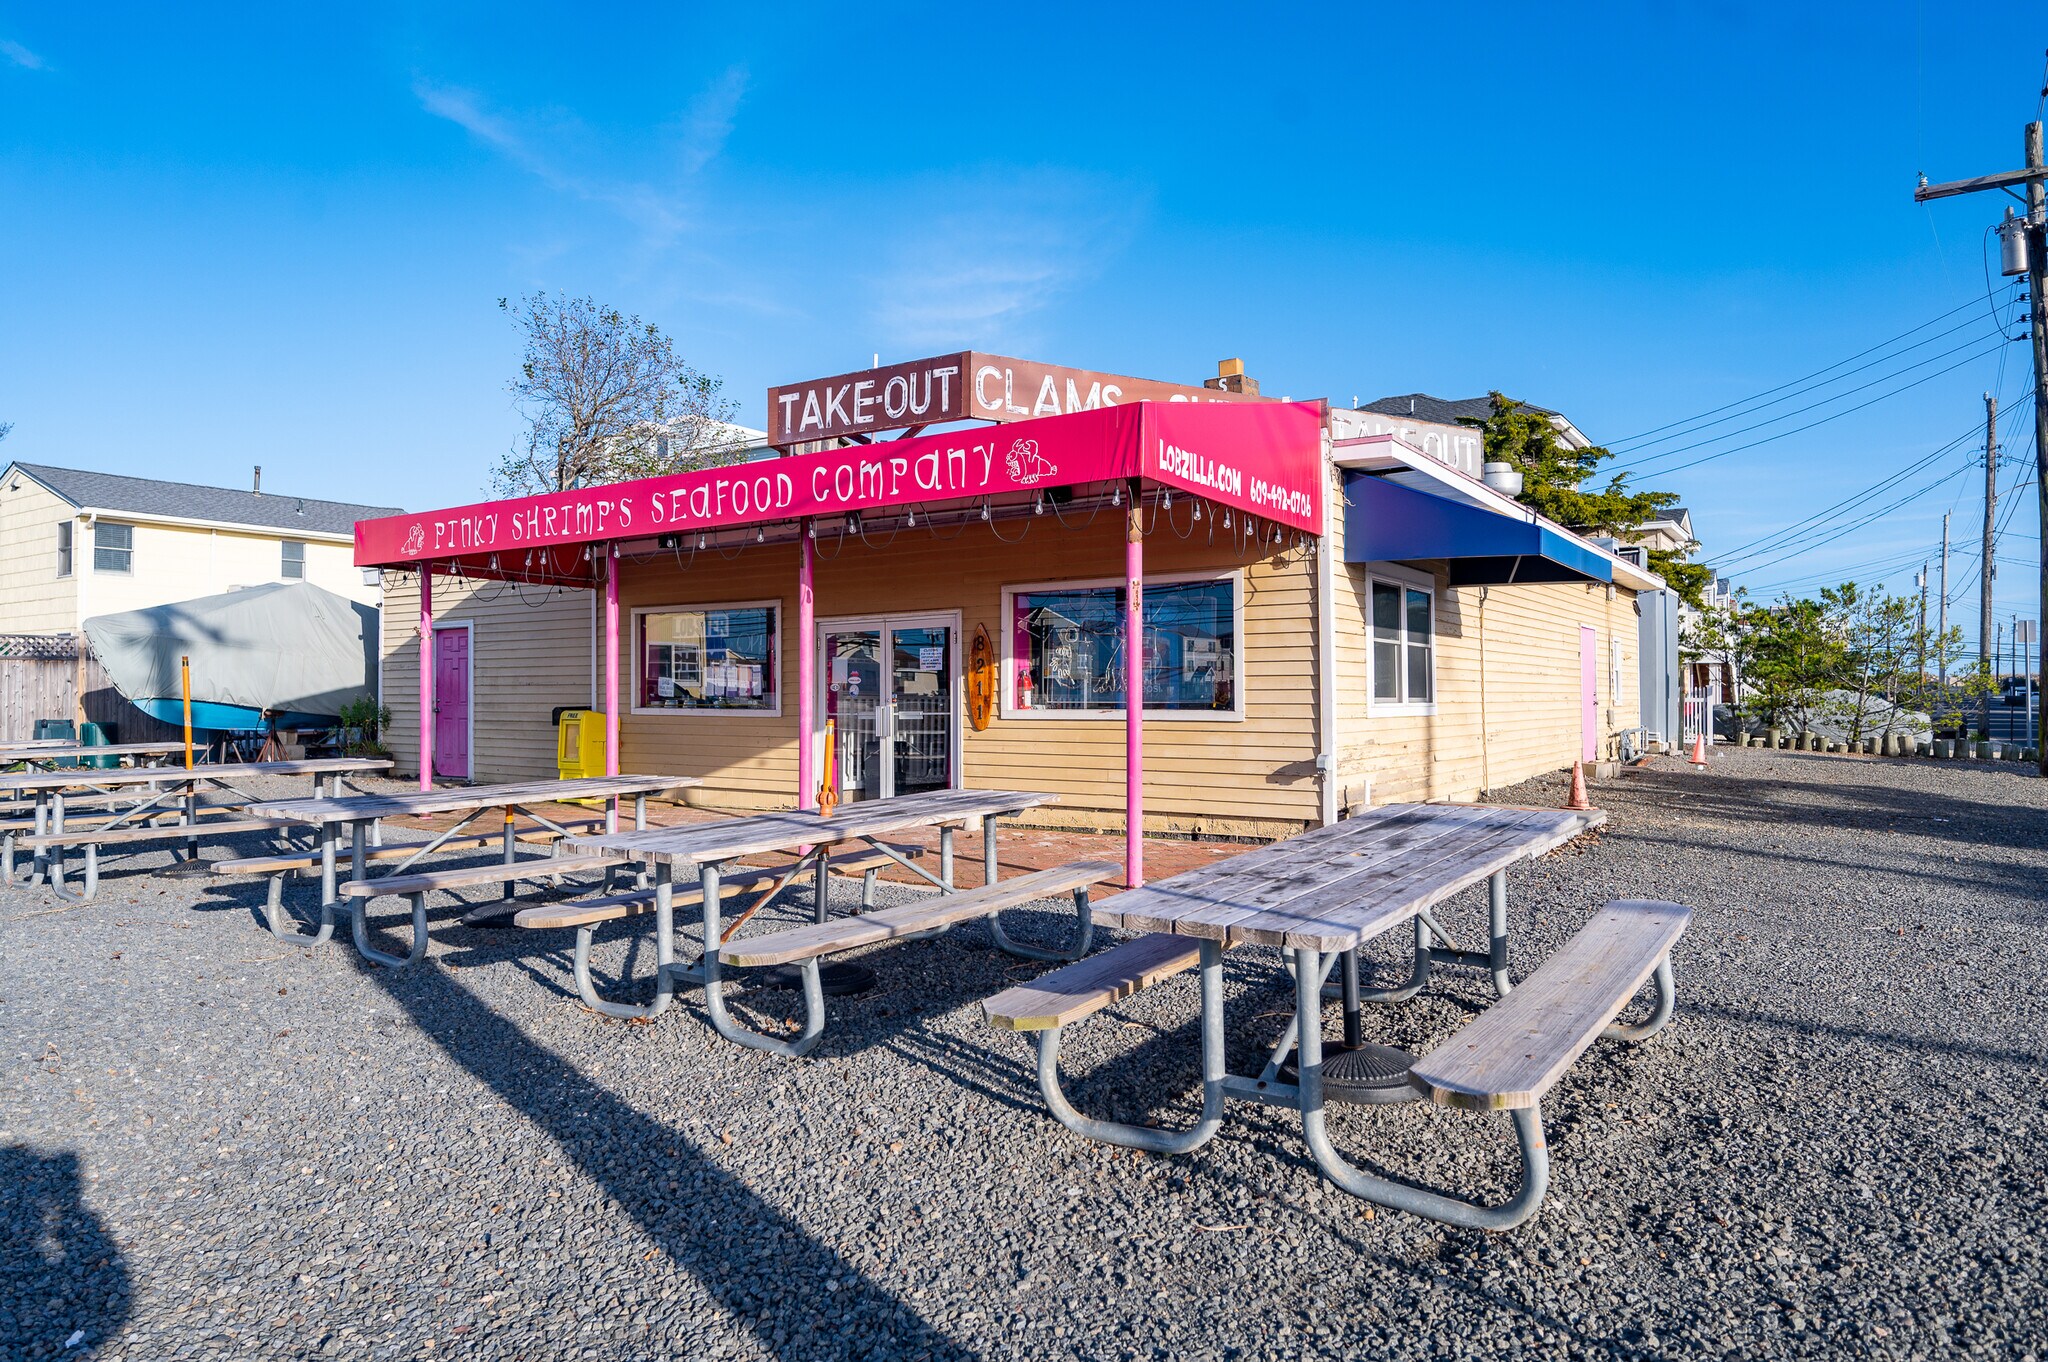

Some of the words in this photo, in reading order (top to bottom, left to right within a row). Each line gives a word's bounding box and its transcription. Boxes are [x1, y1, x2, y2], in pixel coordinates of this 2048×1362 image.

[778, 366, 959, 434] TAKE-OUT
[975, 364, 1123, 416] CLAMS
[1159, 438, 1242, 497] LOBZILLA.COM
[1250, 476, 1312, 518] 609-492-0706
